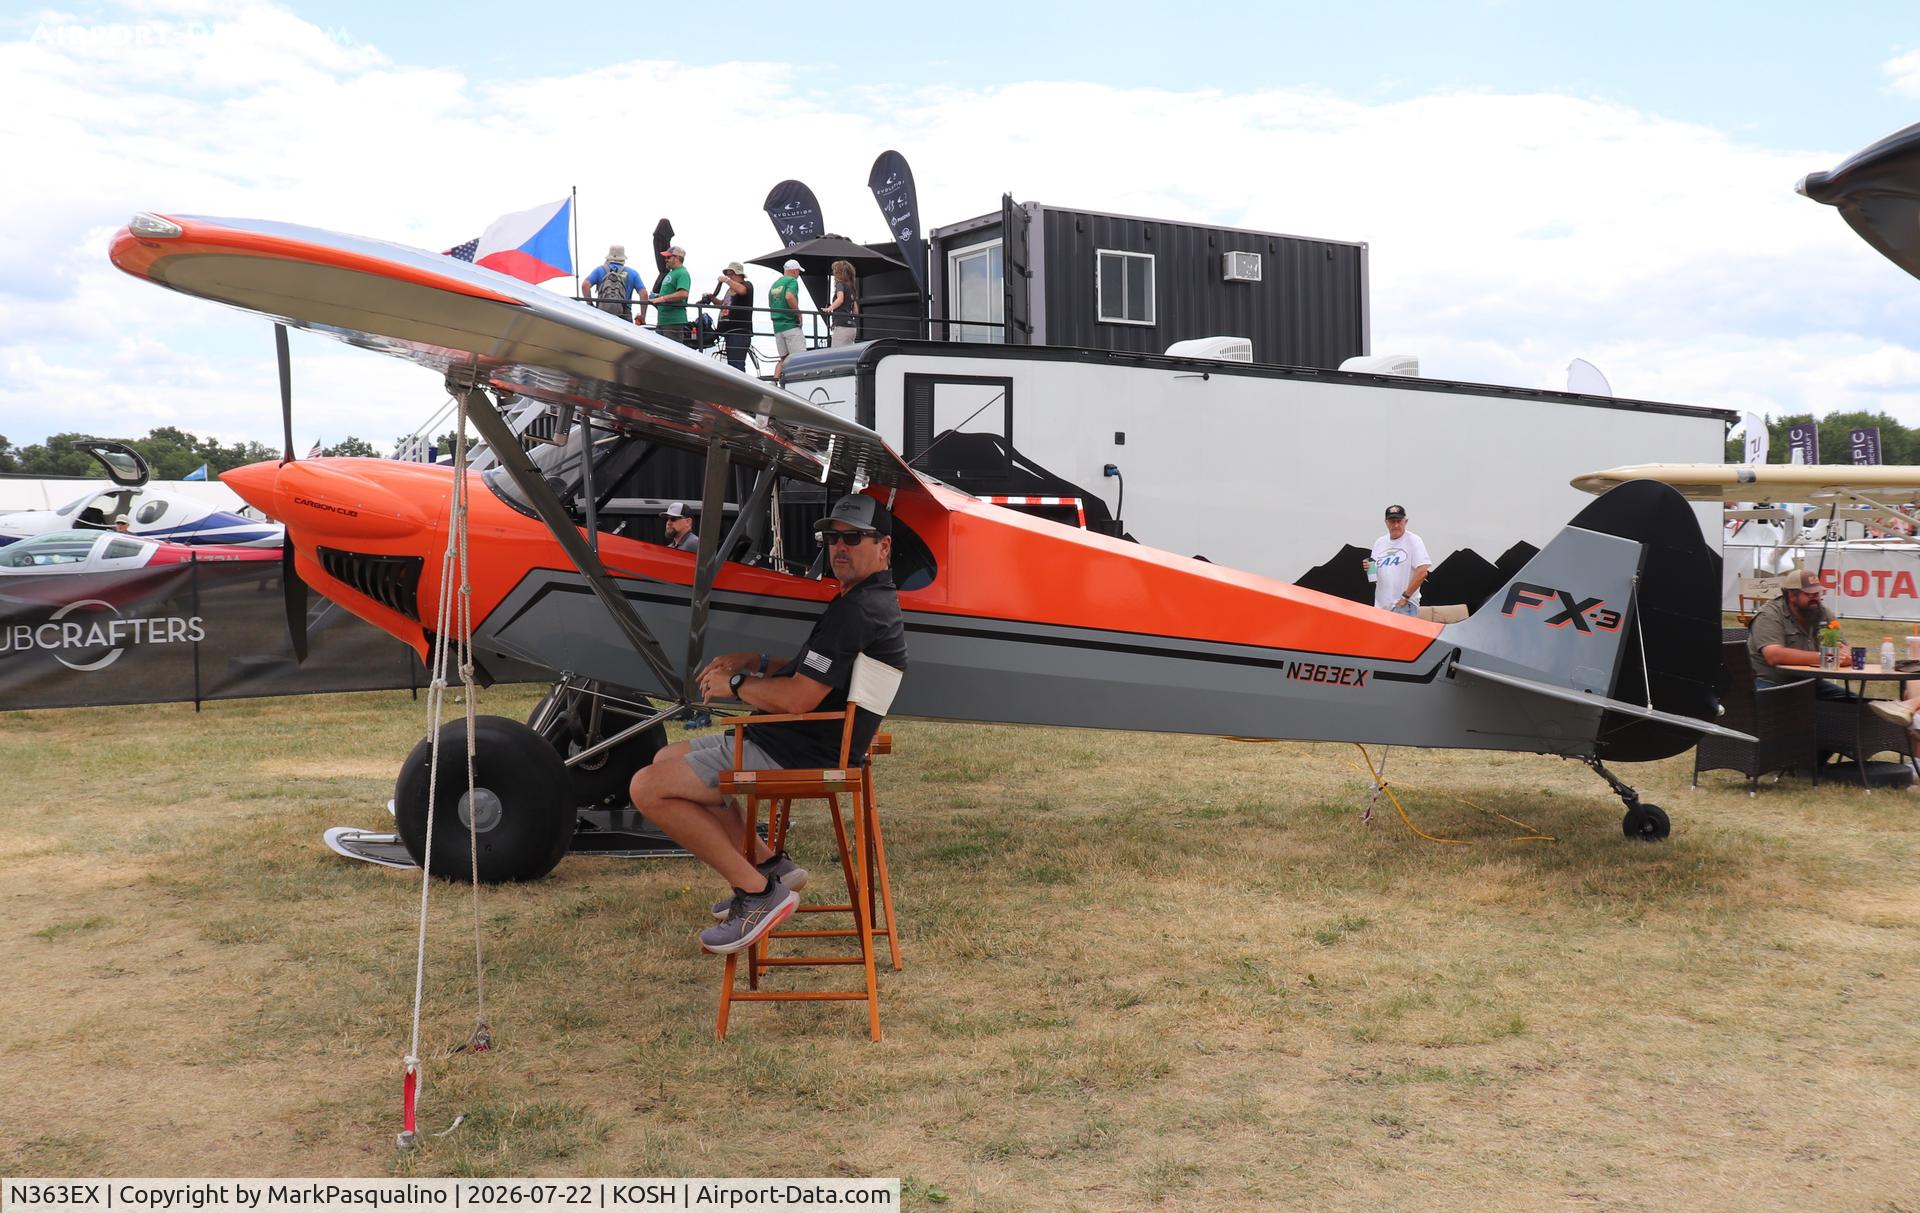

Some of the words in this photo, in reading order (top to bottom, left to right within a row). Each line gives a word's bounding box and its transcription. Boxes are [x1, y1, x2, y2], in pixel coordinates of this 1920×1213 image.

[294, 497, 336, 512] CARBON
[336, 508, 358, 518] CUB
[1286, 660, 1370, 688] N363EX
